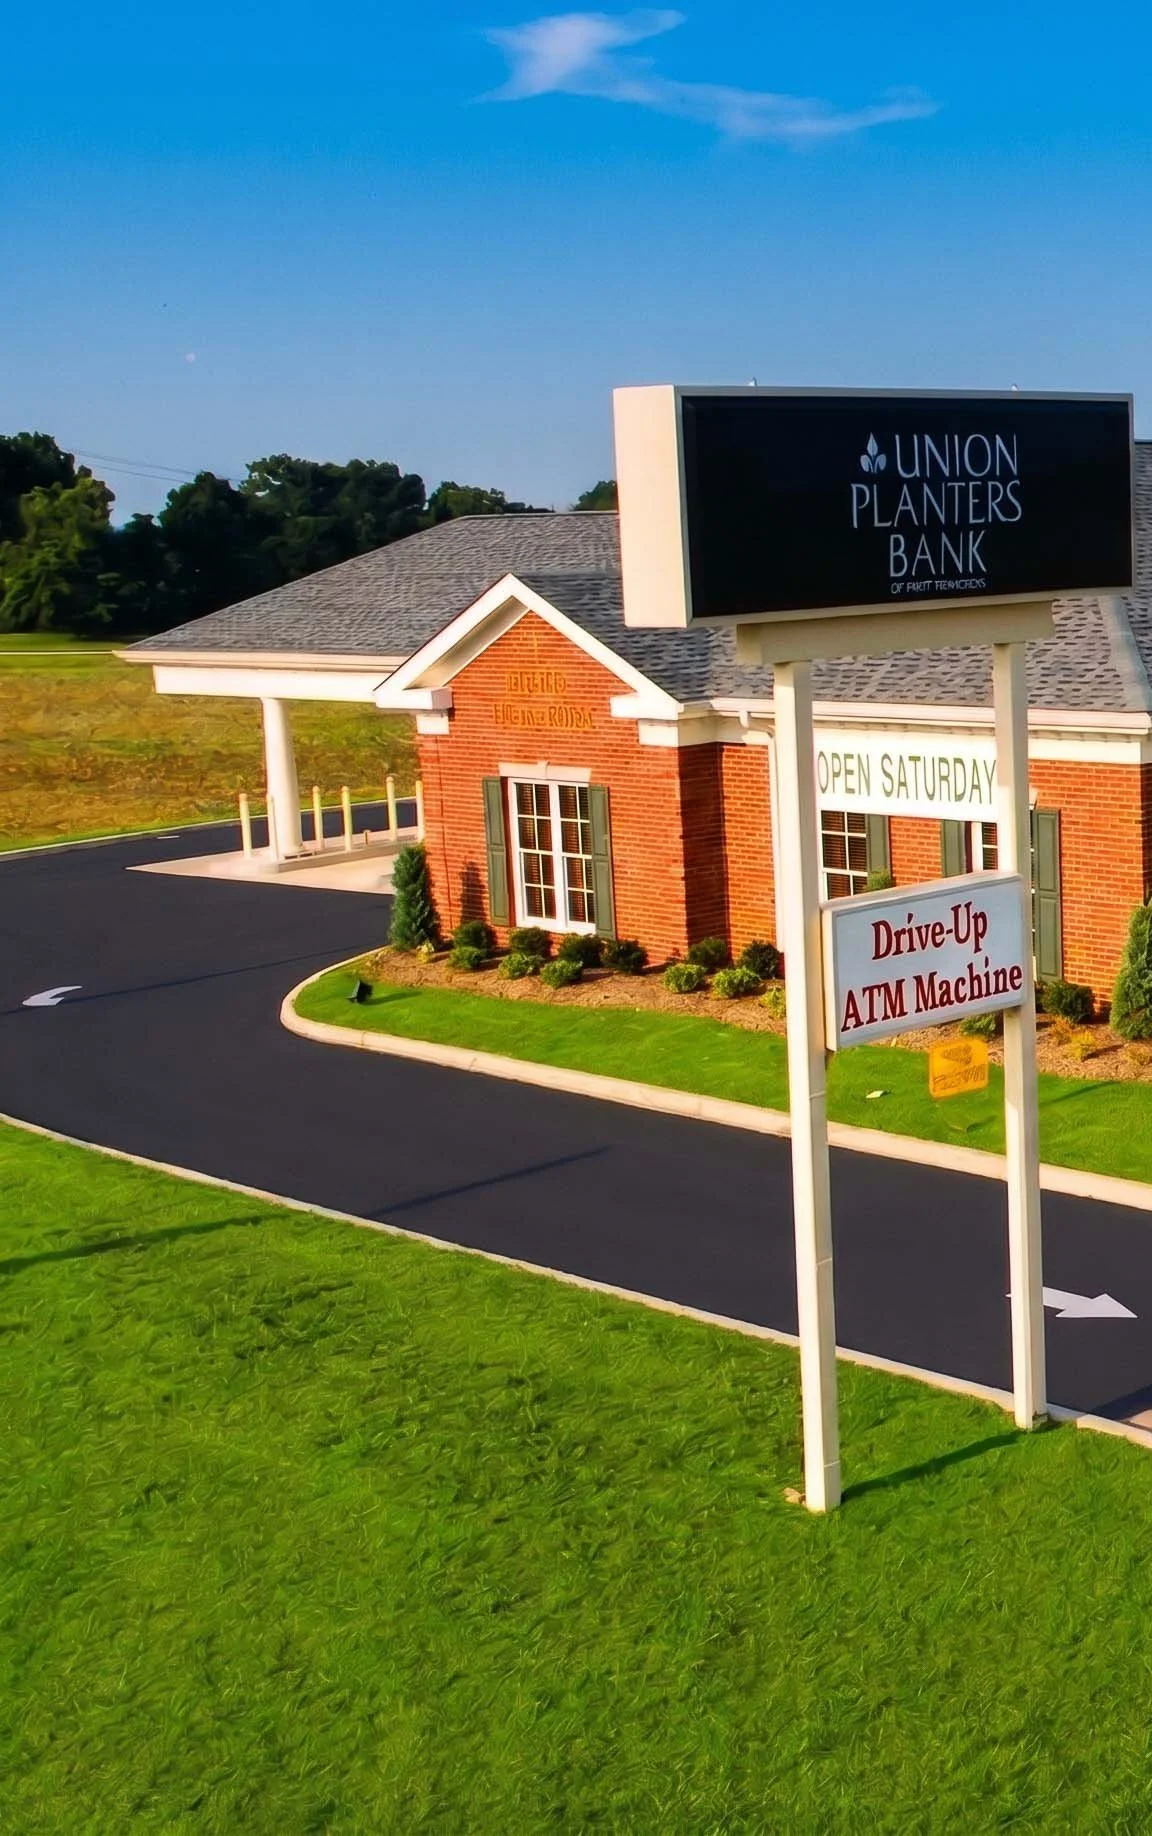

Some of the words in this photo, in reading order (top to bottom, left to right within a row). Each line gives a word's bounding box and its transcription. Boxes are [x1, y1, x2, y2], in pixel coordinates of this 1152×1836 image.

[895, 434, 1018, 478] UNION
[850, 480, 1022, 529] PLANTERS
[889, 530, 987, 577] BANK
[817, 750, 871, 797] OPEN
[881, 752, 997, 805] SATURDAY
[871, 901, 988, 960] Drive-Up
[840, 978, 909, 1033] ATM
[913, 956, 1023, 1013] Machine
